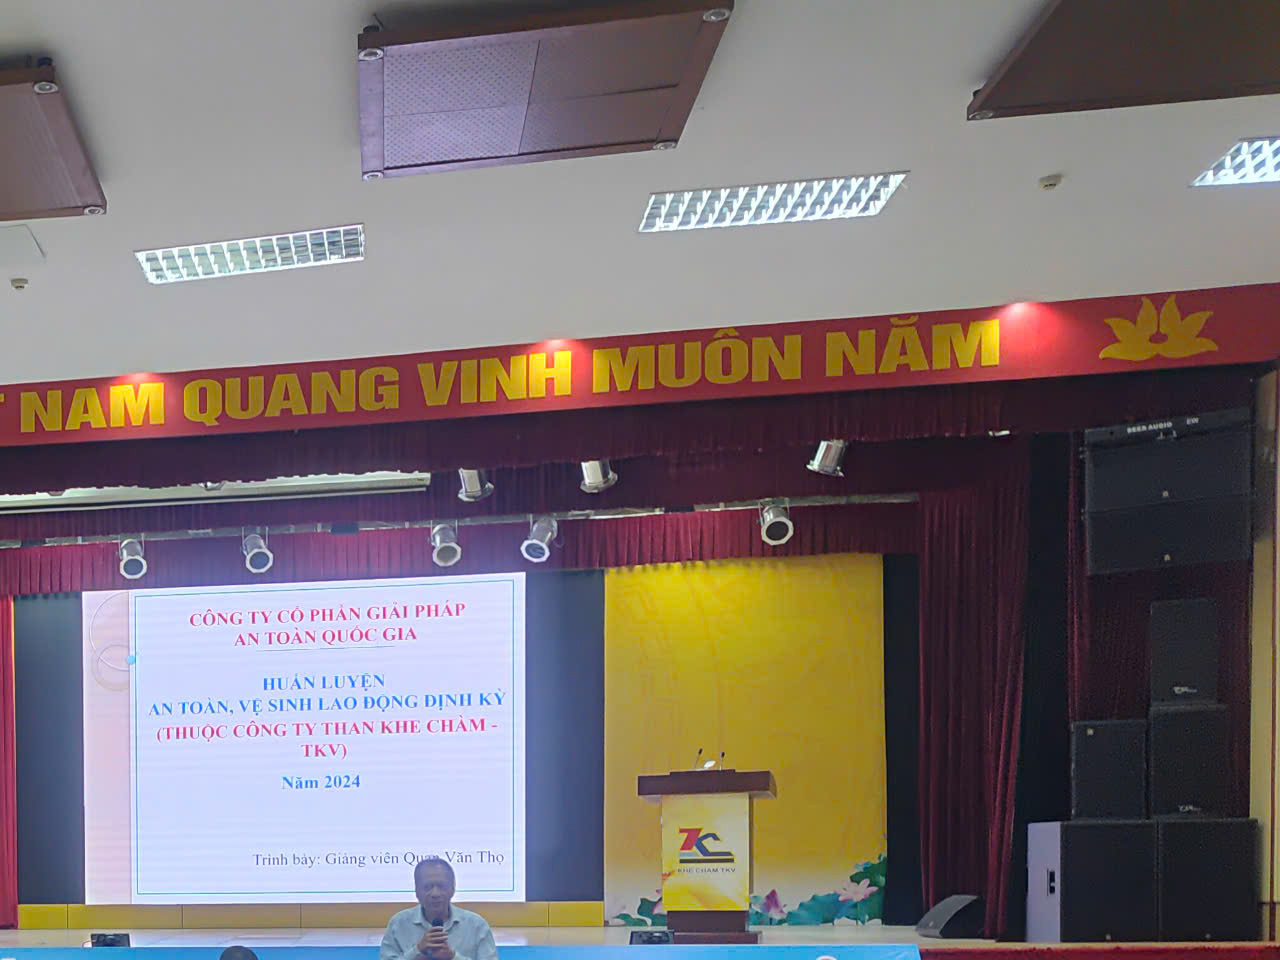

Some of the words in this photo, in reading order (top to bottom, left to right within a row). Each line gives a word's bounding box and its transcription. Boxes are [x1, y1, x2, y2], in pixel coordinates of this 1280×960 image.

[21, 382, 165, 432] NAM
[183, 366, 399, 425] QUANG
[418, 351, 572, 406] VINH
[593, 328, 802, 393] MUÔN
[826, 315, 1000, 377] NĂM
[190, 608, 243, 627] CÔNG
[247, 611, 273, 625] TY
[414, 599, 466, 619] PHÁP
[234, 632, 259, 647] AN
[265, 627, 316, 646] TOÀN
[382, 627, 418, 641] GIA
[321, 673, 385, 692] LUYỆN
[149, 702, 173, 716] AN
[178, 697, 234, 716] TOÀN,
[239, 697, 263, 717] VỆ
[268, 698, 312, 713] SINH
[318, 696, 358, 711] LAO
[363, 693, 418, 713] ĐỘNG
[156, 723, 228, 743] (THUỘC
[233, 720, 288, 739] CÔNG
[292, 722, 318, 737] TY
[320, 720, 375, 736] THAN
[380, 719, 421, 735] KHE
[426, 714, 486, 733] CHÀM
[301, 743, 347, 760] TKV)
[282, 775, 319, 790] Năm
[324, 774, 361, 789] 2024
[371, 851, 399, 865] viên
[445, 851, 473, 863] Văn
[477, 850, 505, 865] Thọ
